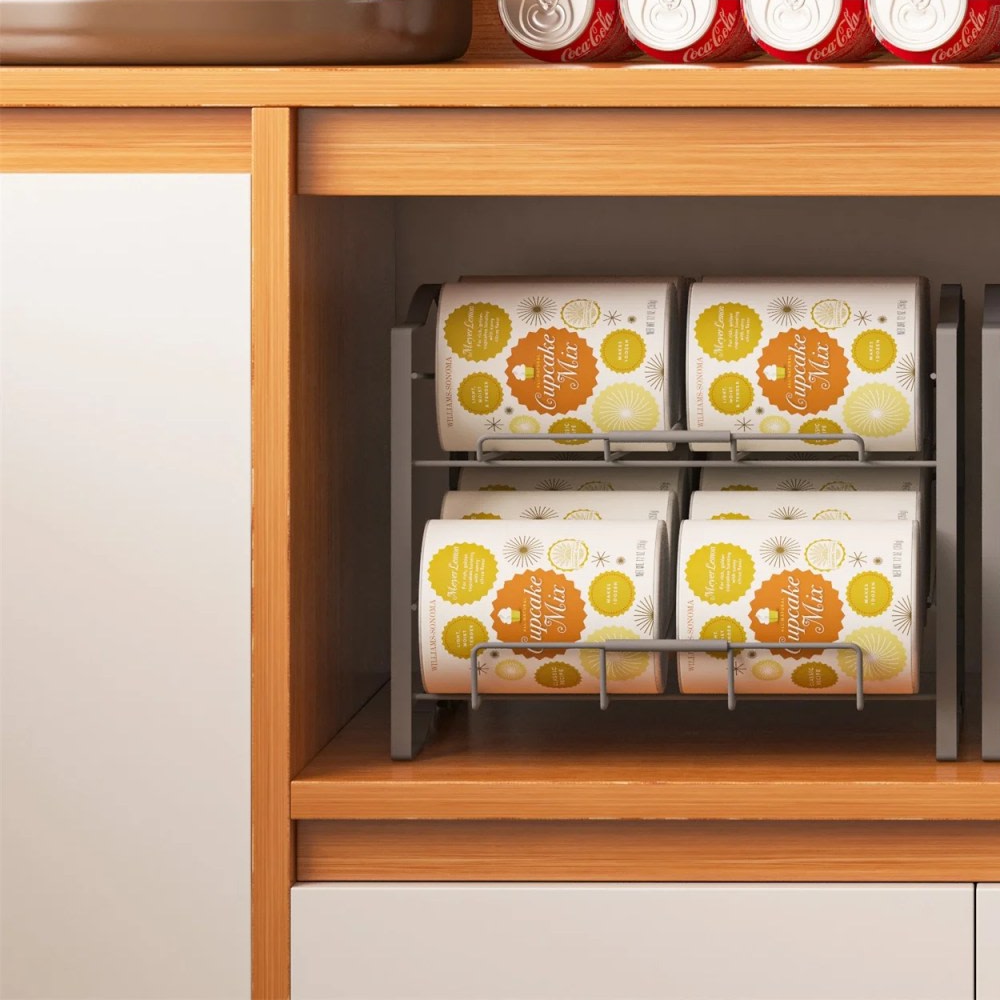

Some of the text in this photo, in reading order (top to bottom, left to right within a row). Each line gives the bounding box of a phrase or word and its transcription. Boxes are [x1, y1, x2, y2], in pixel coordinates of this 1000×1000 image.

[560, 11, 615, 63] Coca-Cola
[682, 11, 738, 63] Coca-Cola
[806, 11, 862, 63] Coca-Cola
[931, 11, 987, 64] Coca-Cola
[535, 334, 557, 410] Cupcake
[557, 342, 579, 389] Mix
[786, 334, 807, 410] Cupcake
[808, 342, 830, 390] Mix
[429, 599, 438, 671] WILLIAMS-SONOMA
[544, 584, 566, 634] Mix
[802, 584, 825, 634] Mix
